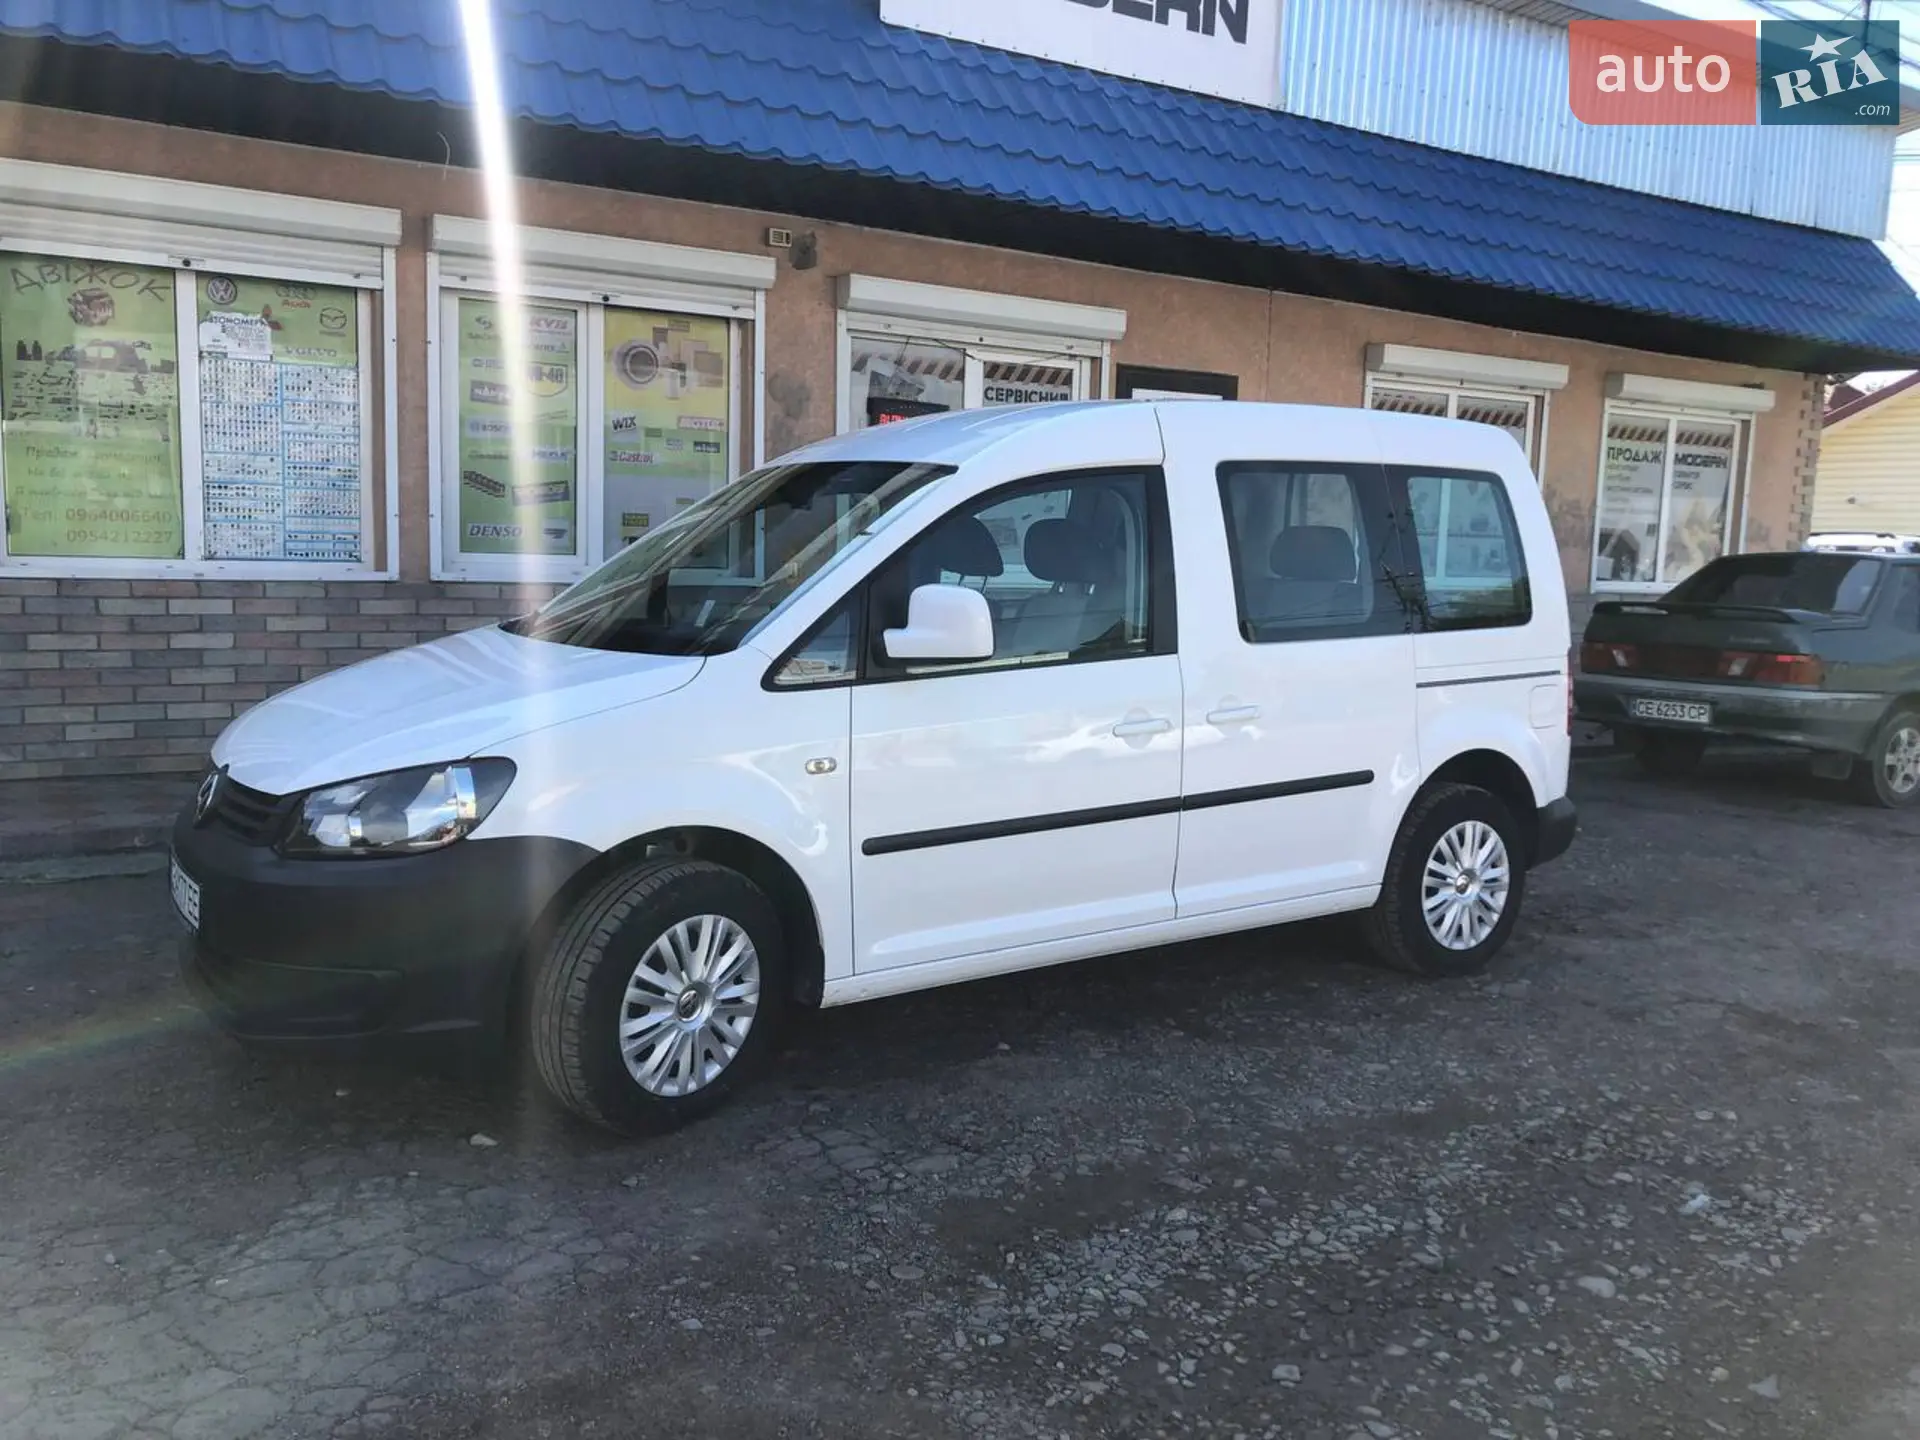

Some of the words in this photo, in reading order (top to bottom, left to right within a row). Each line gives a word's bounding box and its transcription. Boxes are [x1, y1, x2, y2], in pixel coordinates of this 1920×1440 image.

[612, 416, 636, 430] WIX
[1607, 446, 1663, 465] ПРОДАЖ
[469, 525, 523, 537] DENSO
